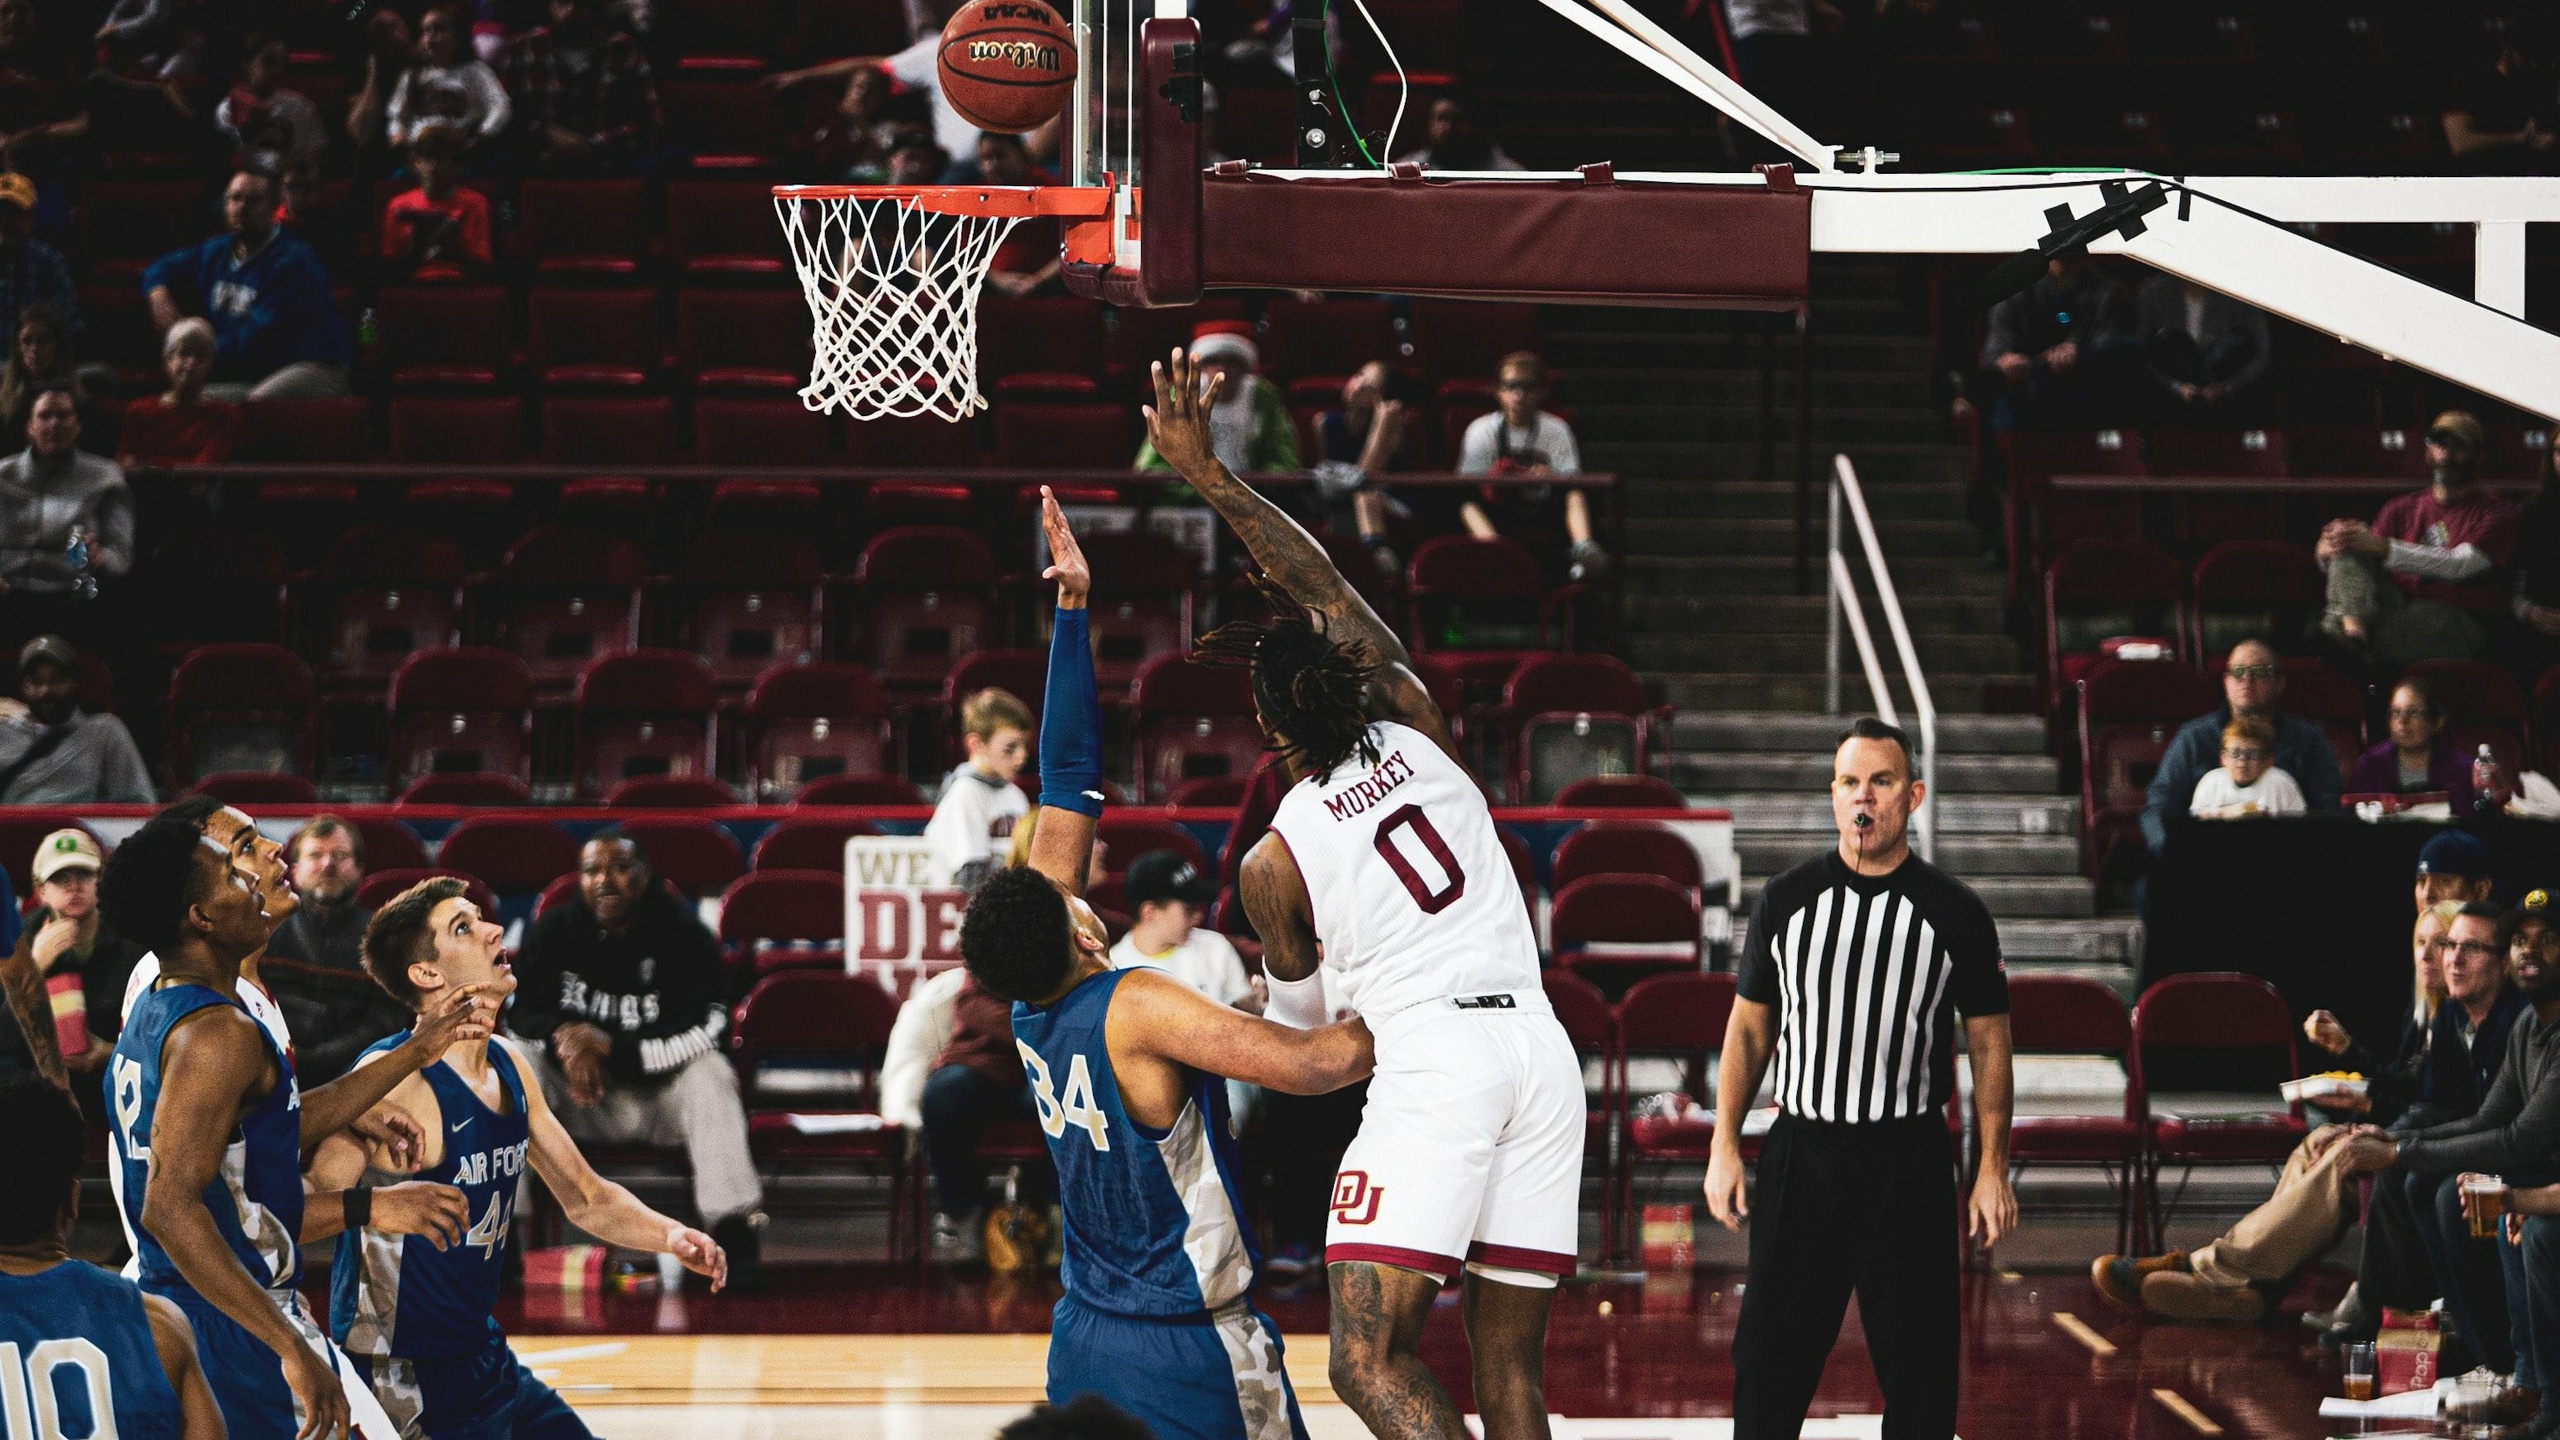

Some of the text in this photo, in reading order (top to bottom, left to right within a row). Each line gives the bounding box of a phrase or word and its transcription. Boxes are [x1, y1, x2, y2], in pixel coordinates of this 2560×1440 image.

[983, 4, 1050, 24] NCAA
[969, 41, 1060, 71] Wilson
[1323, 750, 1415, 822] MURKEY
[856, 853, 930, 885] WE
[1373, 803, 1466, 915] 0
[1016, 1037, 1110, 1151] 34
[452, 1151, 489, 1185] AIR
[1331, 1170, 1385, 1225] DU
[465, 1190, 514, 1261] 44
[0, 1336, 120, 1440] 10
